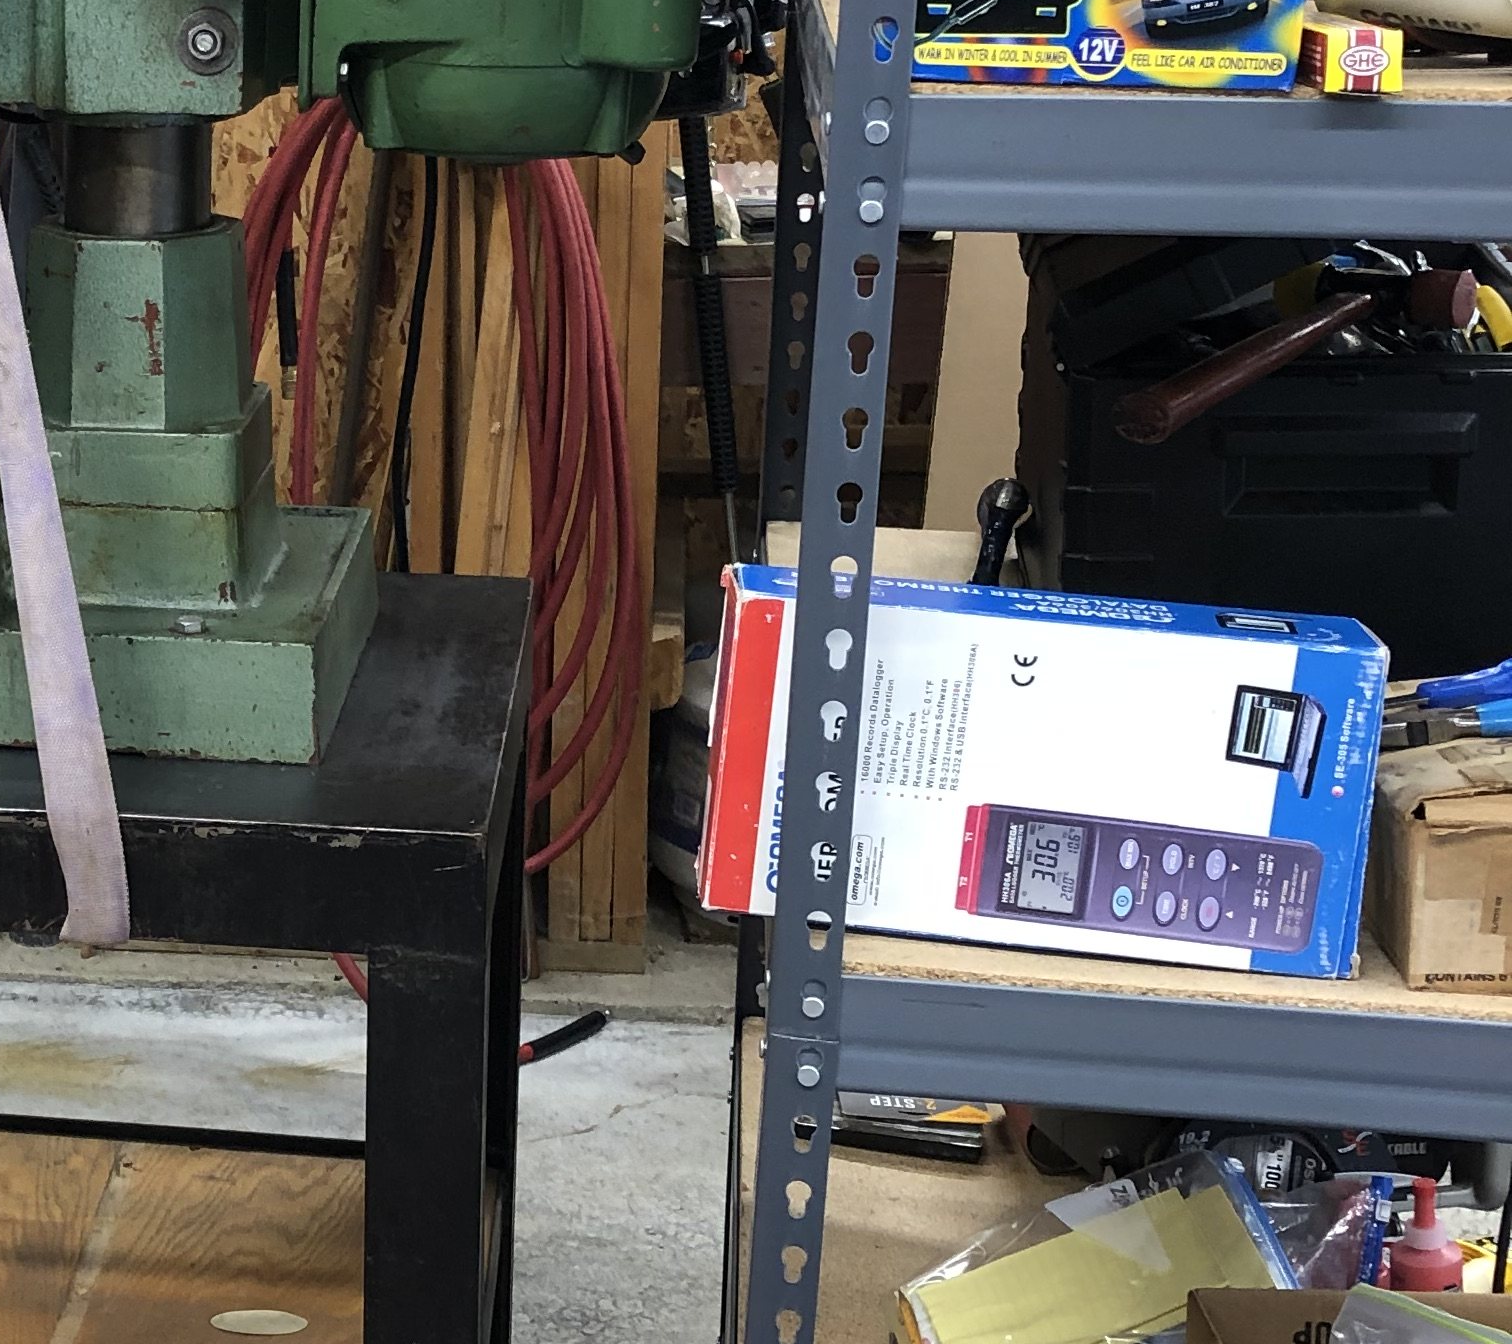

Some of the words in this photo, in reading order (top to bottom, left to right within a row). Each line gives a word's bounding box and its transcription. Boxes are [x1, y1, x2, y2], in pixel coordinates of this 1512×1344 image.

[918, 46, 943, 60] WARM
[944, 47, 956, 60] IN
[958, 48, 988, 62] WINTER
[998, 49, 1021, 63] COOL
[1022, 50, 1035, 63] IN
[1036, 51, 1068, 64] SUMMER
[1078, 38, 1119, 63] 12V
[1130, 52, 1152, 67] FEEL
[1154, 53, 1176, 68] LIKE
[1177, 55, 1196, 69] CAR
[1198, 55, 1216, 69] AIR
[1217, 56, 1284, 72] CONDITIONER
[1343, 53, 1385, 68] GHE
[869, 659, 885, 713] Datalogger
[934, 678, 949, 721] Software
[864, 713, 877, 754] Records
[873, 761, 886, 784] Easy
[881, 679, 895, 727] Operation
[890, 720, 904, 756] Display
[906, 711, 917, 739] Clock
[902, 739, 913, 763] Time
[928, 722, 942, 765] Windows
[860, 755, 872, 782] 16000
[886, 757, 898, 784] Triple
[899, 765, 910, 786] Real
[912, 735, 927, 787] Resolution
[939, 755, 951, 790] RS-232
[949, 757, 962, 791] RS-232
[925, 765, 936, 789] With
[851, 841, 865, 901] omega.com
